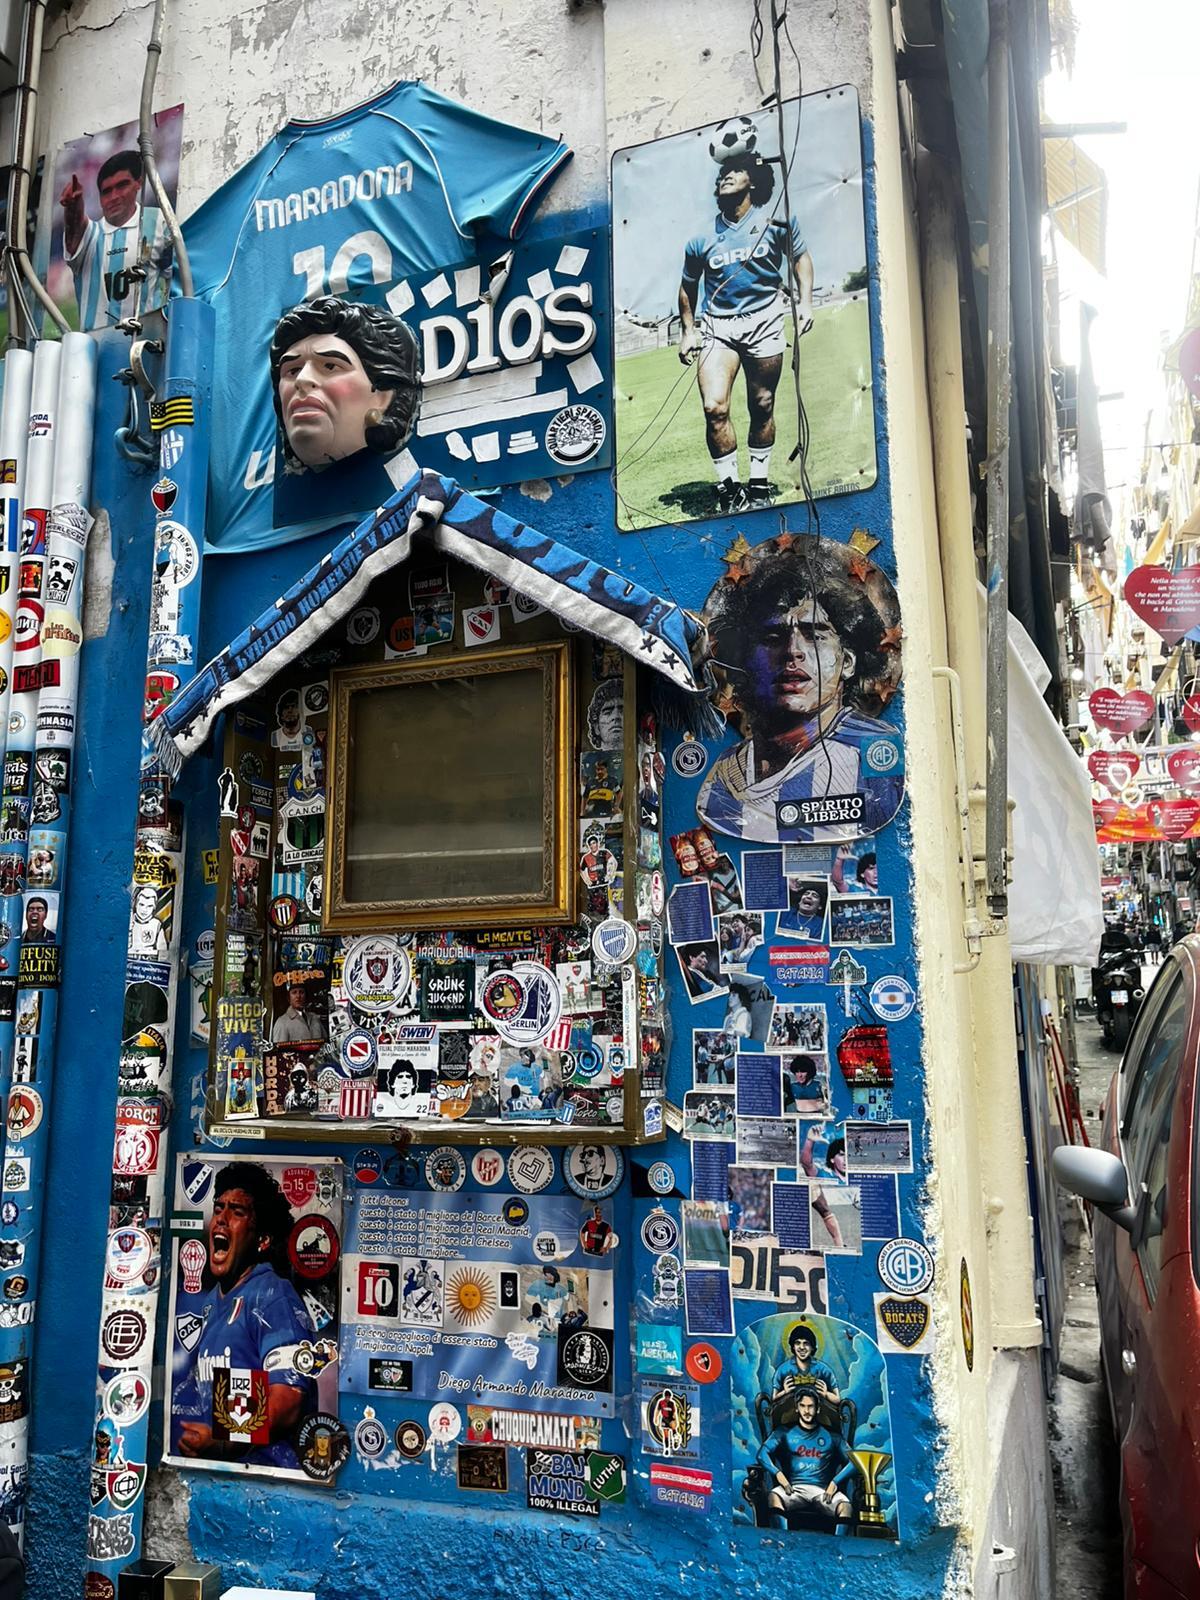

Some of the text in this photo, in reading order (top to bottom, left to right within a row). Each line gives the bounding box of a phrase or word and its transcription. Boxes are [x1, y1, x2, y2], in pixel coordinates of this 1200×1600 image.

[255, 160, 413, 232] MARADONA
[293, 230, 392, 300] 10
[548, 407, 602, 450] QUARTIERI SPAGNOLI
[801, 797, 863, 824] SPIRITO LIBERO
[476, 930, 532, 944] LA MENTE
[776, 967, 824, 980] CATANIA
[428, 976, 465, 991] GRÜNE
[427, 992, 465, 1004] JUGEND
[218, 1003, 262, 1019] DIEGO
[223, 1018, 258, 1034] VIVE
[510, 1020, 537, 1028] BERLIN
[147, 1028, 165, 1051] ITALIA
[400, 1027, 433, 1038] SWERV
[266, 1056, 279, 1115] HORDA
[118, 1108, 157, 1125] FORCE
[416, 1105, 428, 1113] 22
[293, 1178, 304, 1191] 15
[360, 1209, 385, 1218] questo
[387, 1207, 393, 1217] è
[395, 1209, 416, 1218] stato
[418, 1209, 425, 1219] il
[426, 1210, 459, 1222] migliore
[461, 1210, 474, 1222] del
[360, 1220, 532, 1237] questo è stato il migliore del Real Madrid,
[359, 1231, 513, 1249] questo è stato il migliore del Chelsea,
[359, 1243, 385, 1254] questo
[387, 1244, 393, 1253] è
[394, 1244, 416, 1254] stato
[417, 1245, 425, 1255] il
[363, 1276, 394, 1307] 10
[885, 1312, 925, 1324] BOCATS
[363, 1340, 396, 1354] migliore
[398, 1344, 403, 1352] a
[388, 1331, 430, 1346] orgoglioso
[432, 1331, 440, 1343] di
[442, 1335, 472, 1346] essere
[473, 1337, 498, 1348] stato
[232, 1377, 251, 1391] IRR
[438, 1371, 596, 1401] Diego Armando Maradona
[530, 1497, 598, 1515] 100% ILLEGAL
